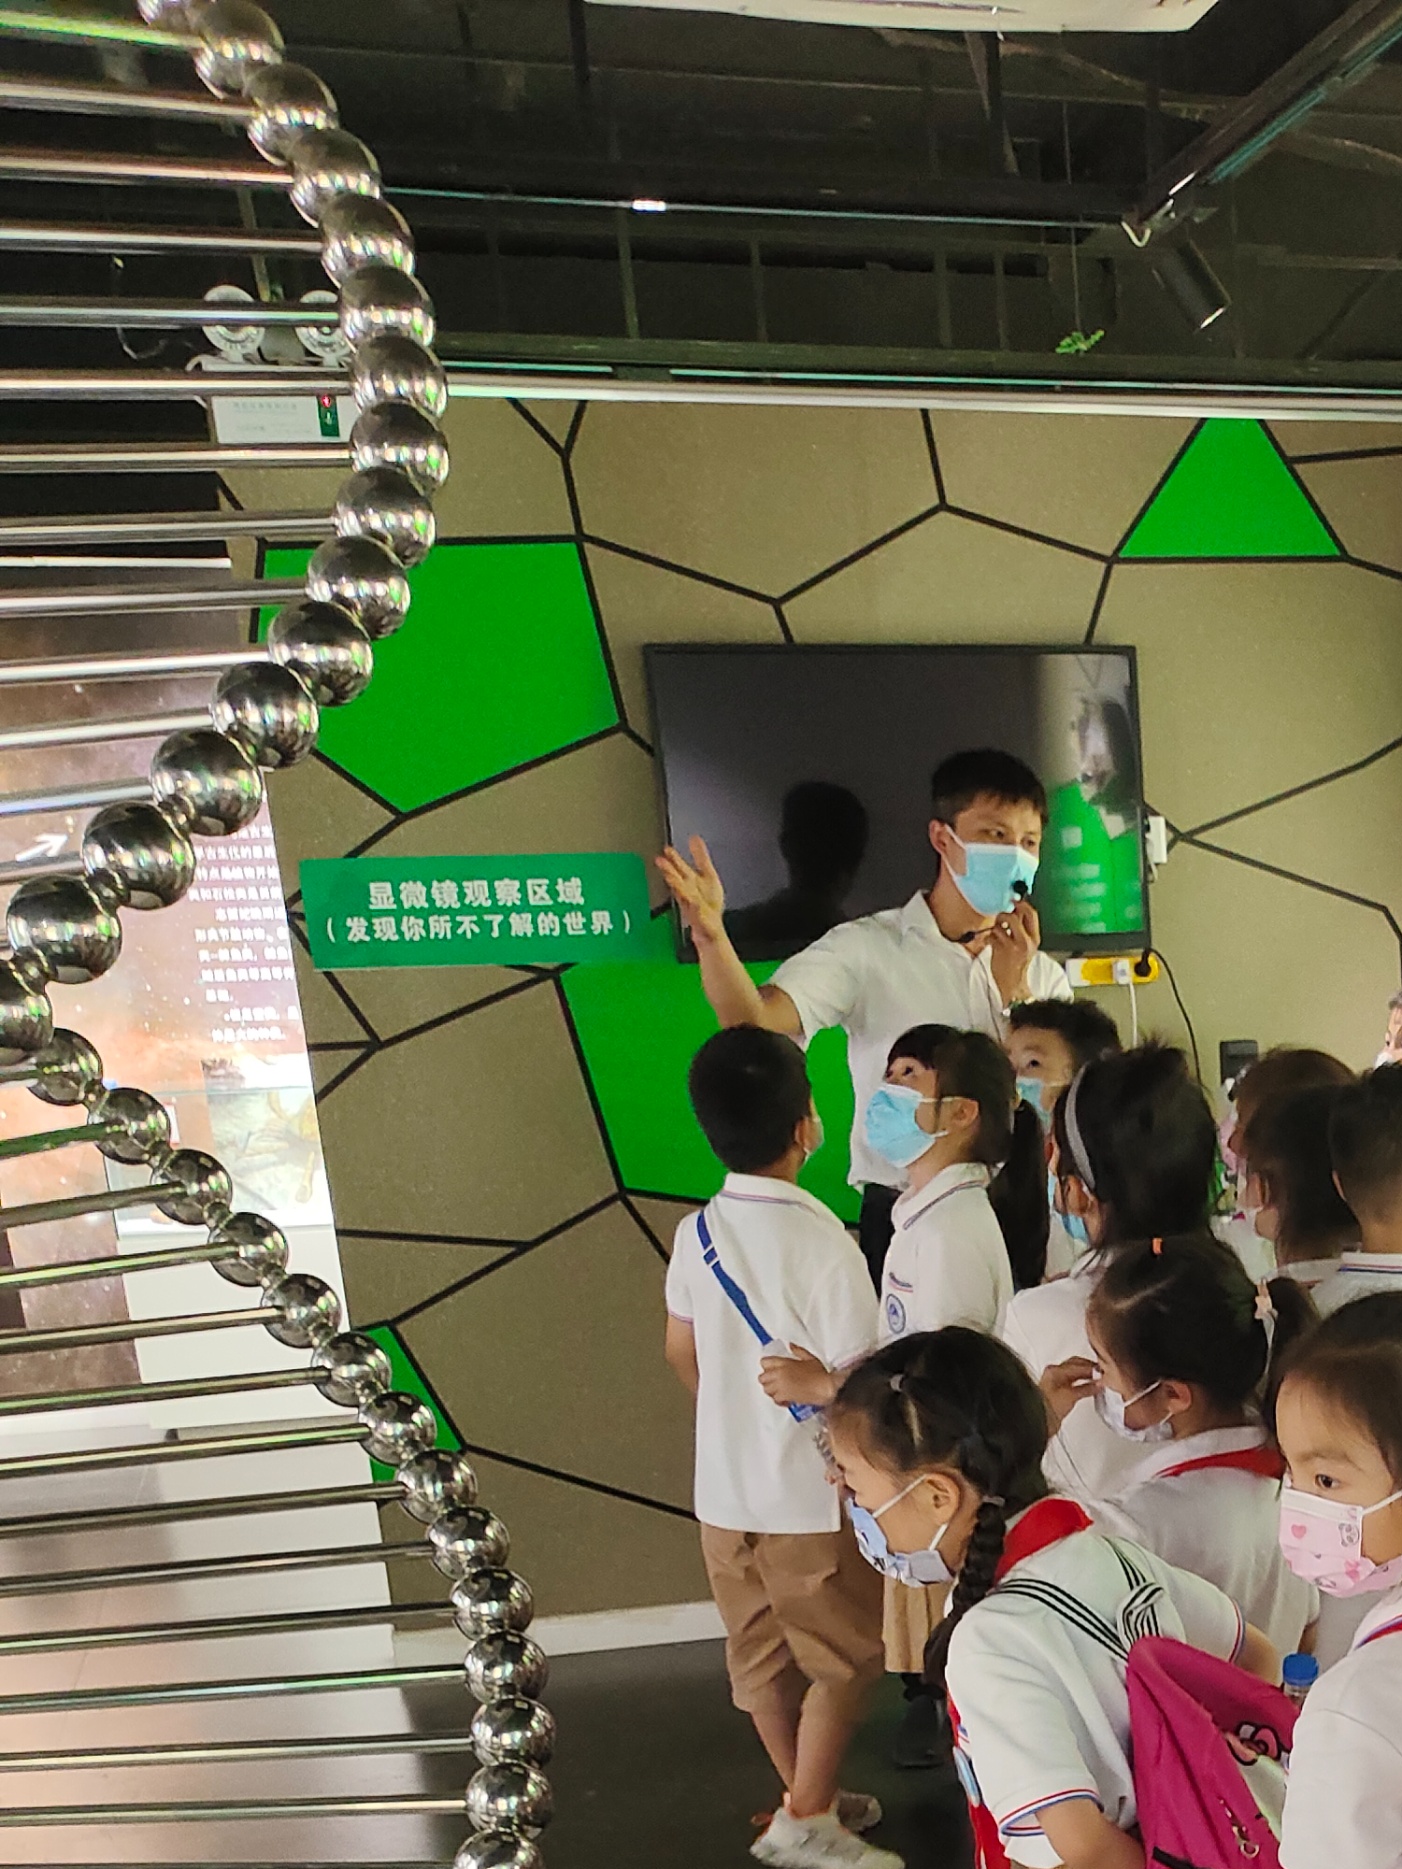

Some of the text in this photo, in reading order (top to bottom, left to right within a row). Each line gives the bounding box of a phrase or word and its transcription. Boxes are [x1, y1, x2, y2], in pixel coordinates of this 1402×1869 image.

[368, 877, 585, 911] 显微镜观察区域
